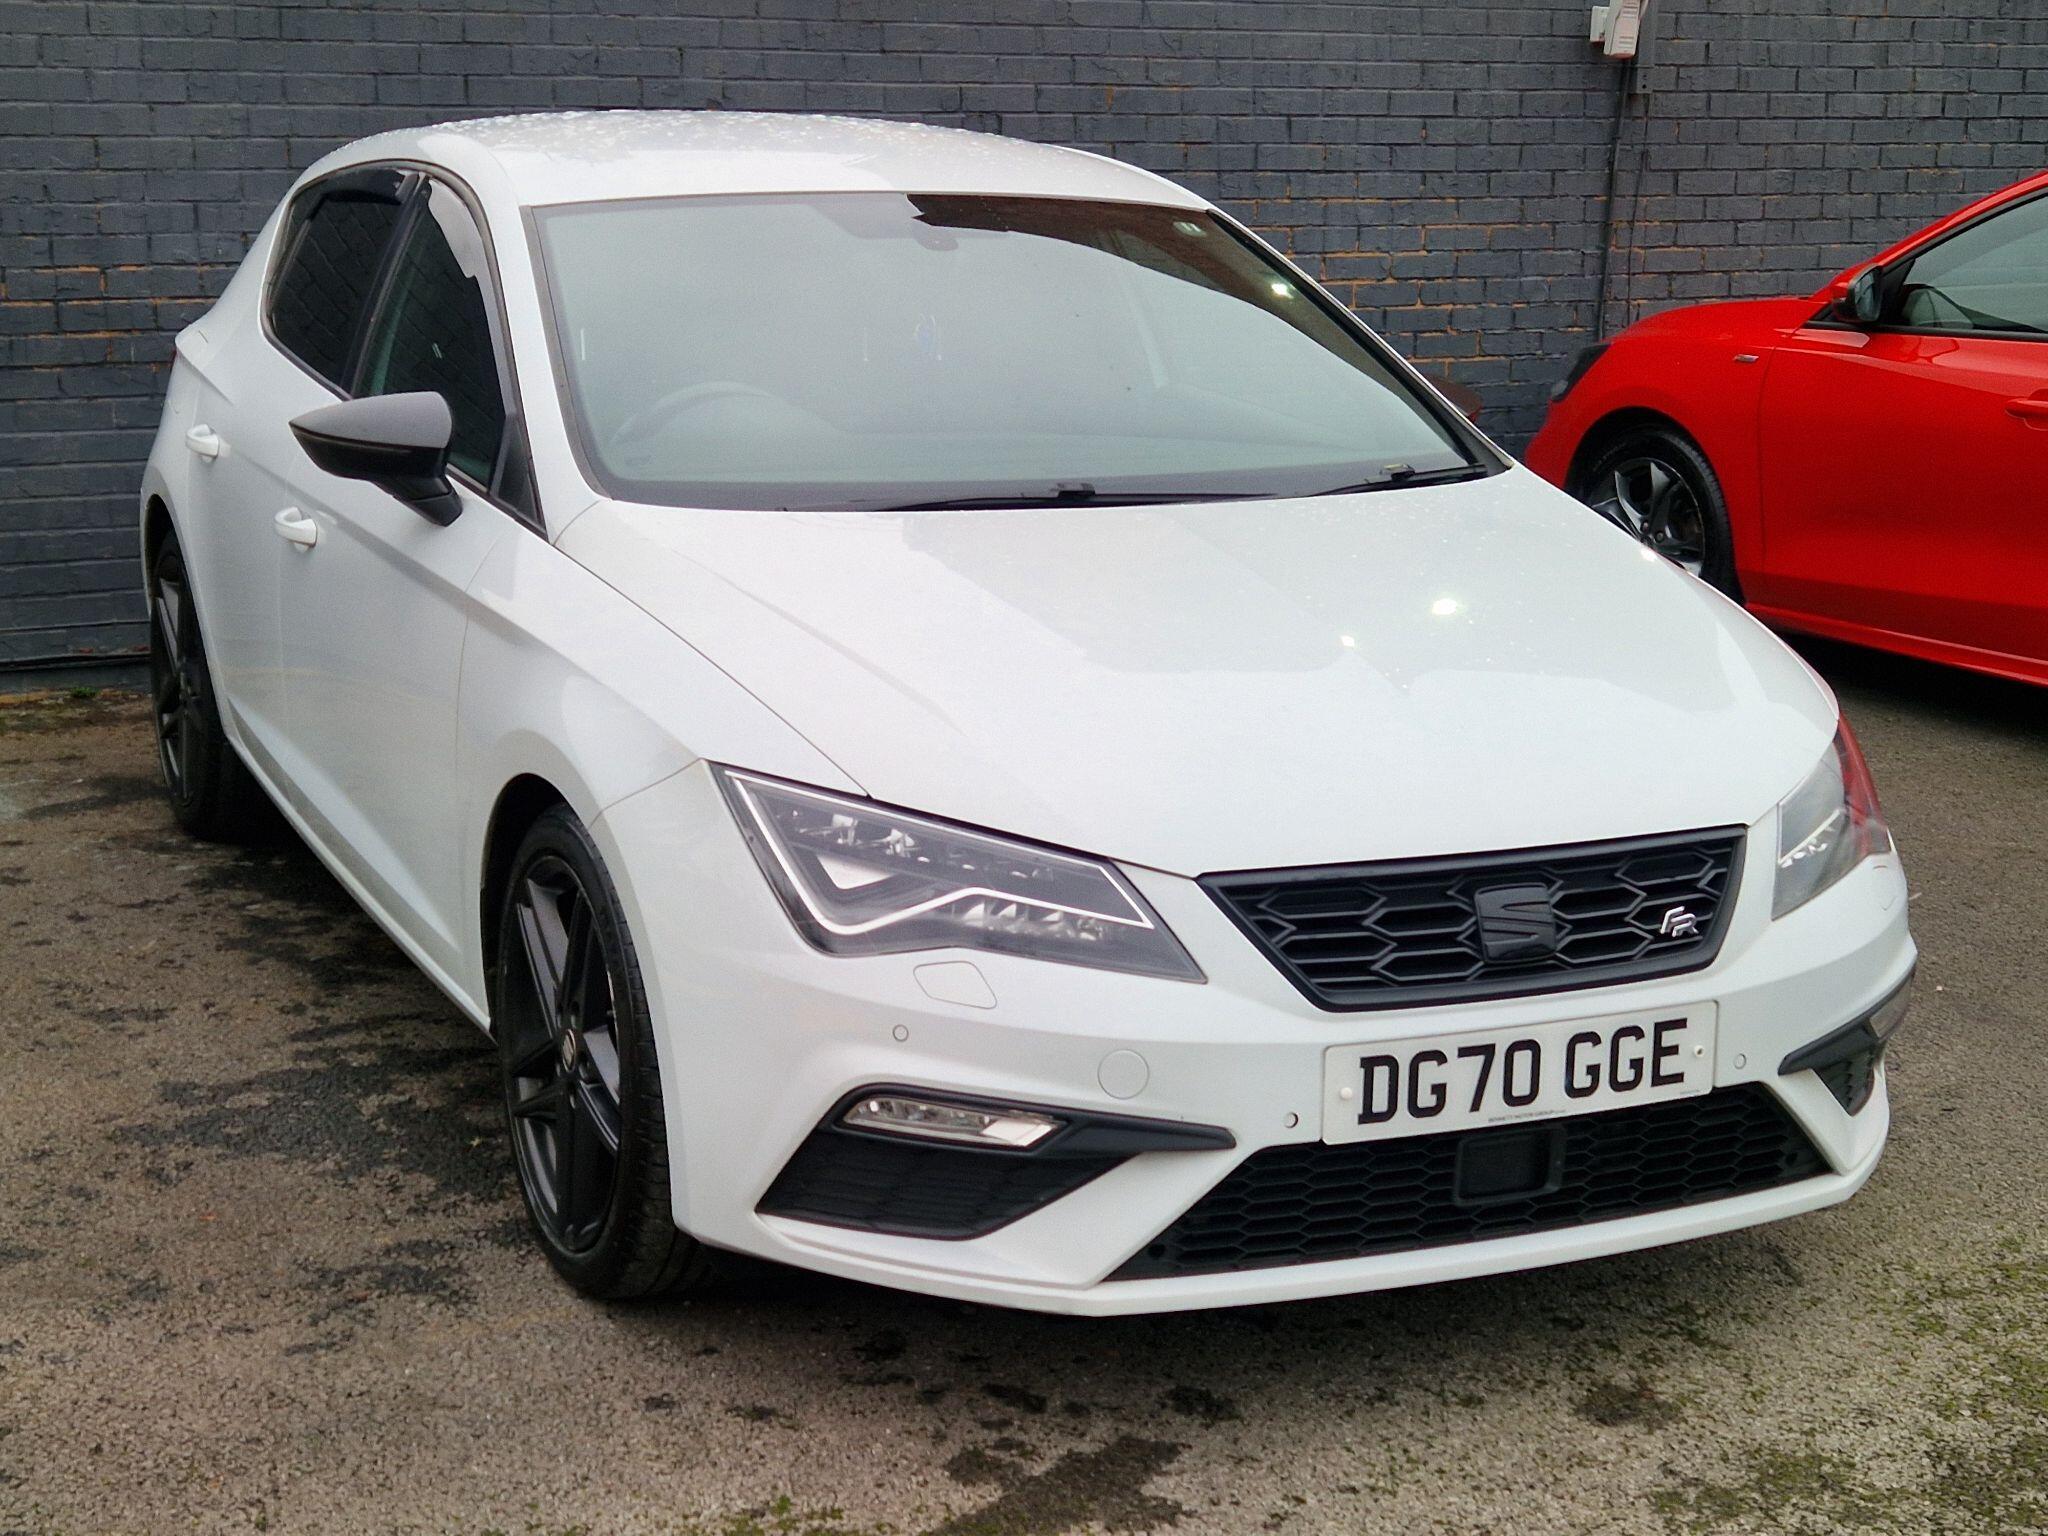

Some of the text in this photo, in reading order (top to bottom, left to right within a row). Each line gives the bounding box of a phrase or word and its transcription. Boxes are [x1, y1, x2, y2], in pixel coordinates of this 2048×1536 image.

[1660, 906, 1699, 937] FR
[1358, 1017, 1688, 1125] DG70 GGE
